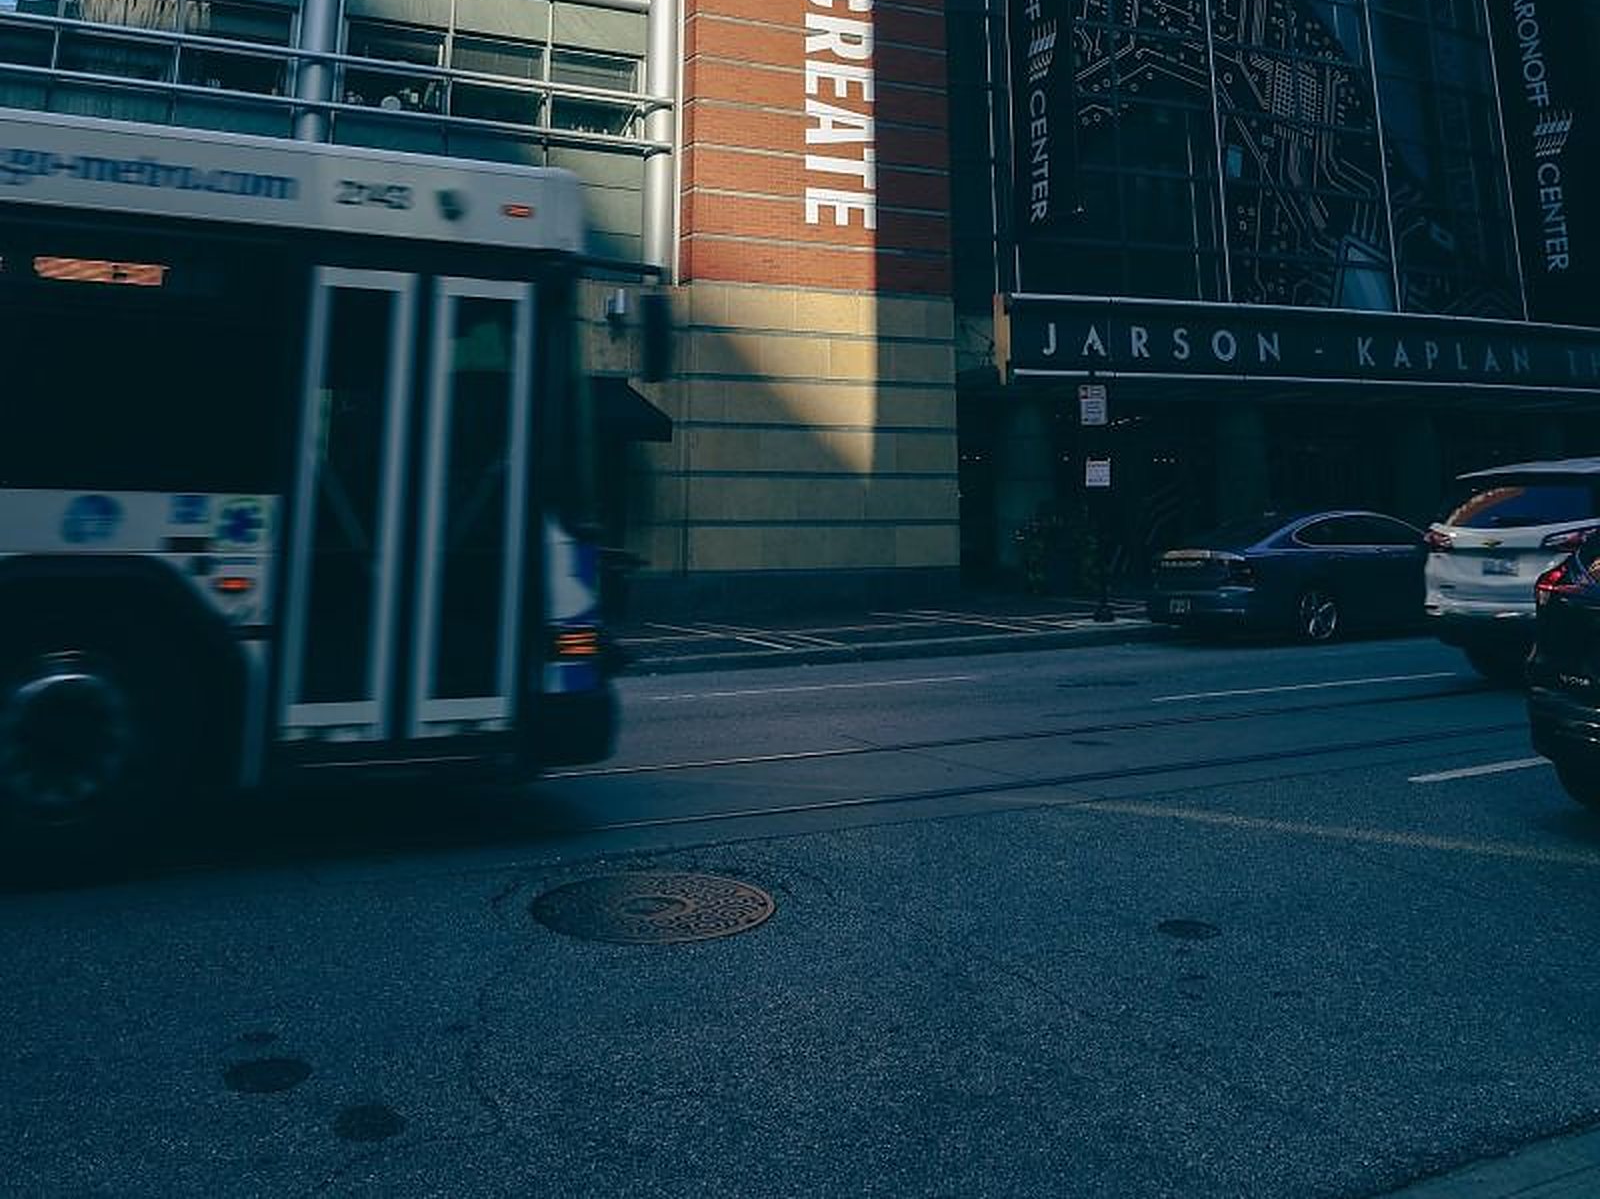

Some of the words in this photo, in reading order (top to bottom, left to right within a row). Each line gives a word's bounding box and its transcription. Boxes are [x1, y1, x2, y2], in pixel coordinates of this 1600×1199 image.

[1029, 89, 1050, 224] CENTER
[1536, 161, 1570, 272] CENTER
[1043, 322, 1281, 363] JARSON
[1356, 335, 1531, 374] KAPLAN
